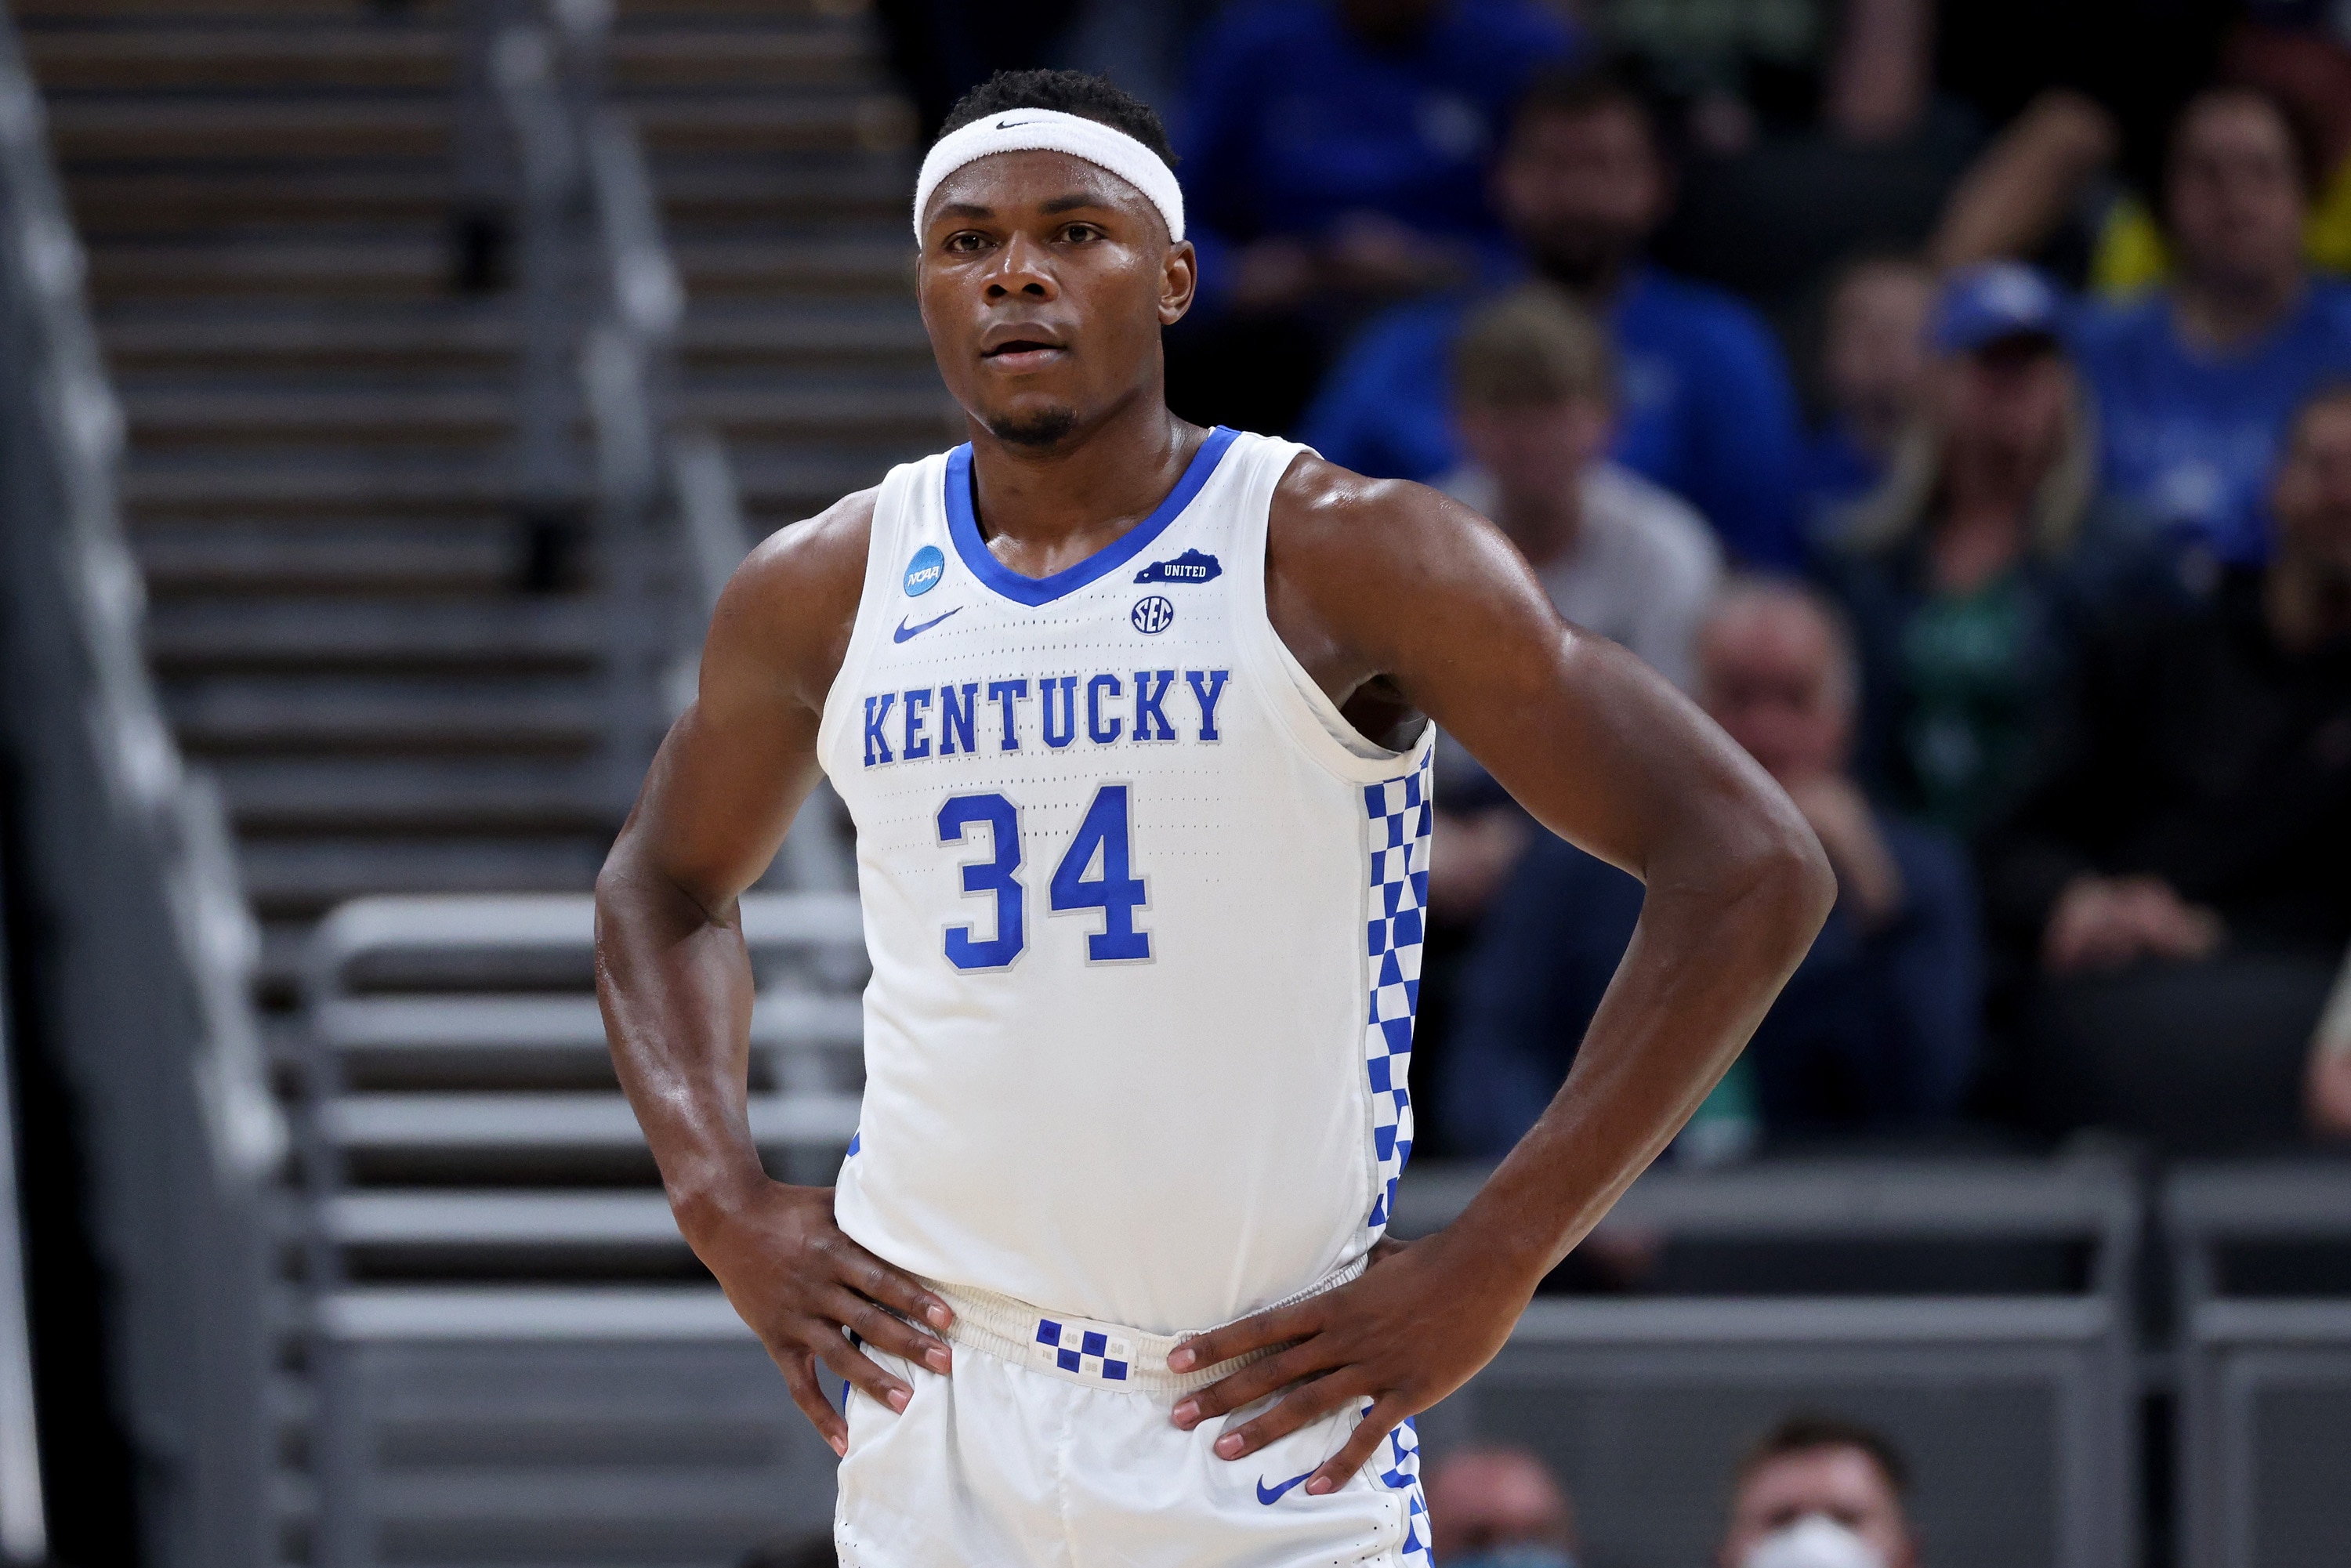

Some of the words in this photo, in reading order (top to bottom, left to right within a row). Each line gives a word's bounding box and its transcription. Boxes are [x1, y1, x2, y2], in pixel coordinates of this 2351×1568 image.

[907, 565, 940, 588] NCAA
[1164, 564, 1207, 578] UNITED
[1133, 597, 1172, 632] SEC
[863, 669, 1231, 771] KENTUCKY
[933, 779, 1156, 975] 34
[1065, 1333, 1078, 1344] 49
[1110, 1342, 1124, 1354] 58
